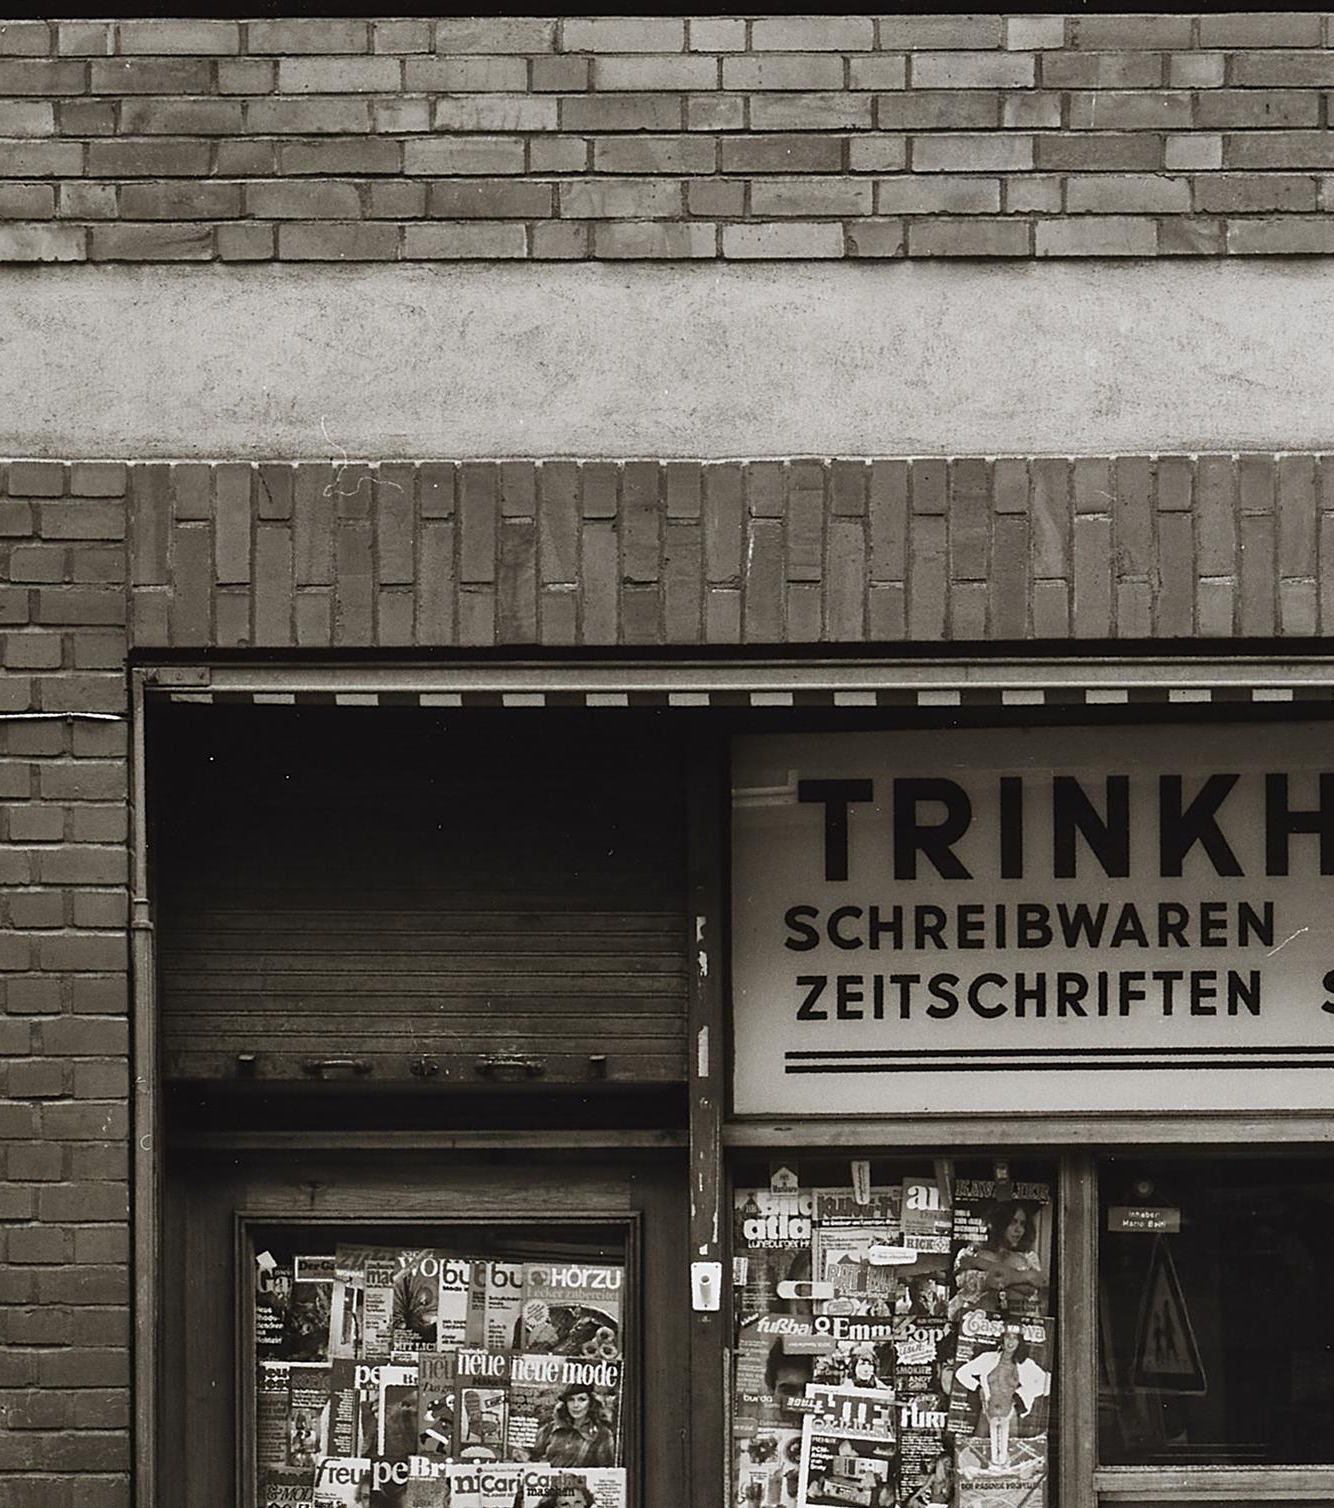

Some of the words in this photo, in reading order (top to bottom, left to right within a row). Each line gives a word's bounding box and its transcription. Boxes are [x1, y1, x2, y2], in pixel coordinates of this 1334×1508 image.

[784, 901, 1276, 953] SCHREIBWAREN
[795, 970, 1262, 1022] ZEITSCHRIFTEN
[458, 1353, 505, 1376] neue
[511, 1356, 559, 1382] neue
[563, 1360, 618, 1387] mode
